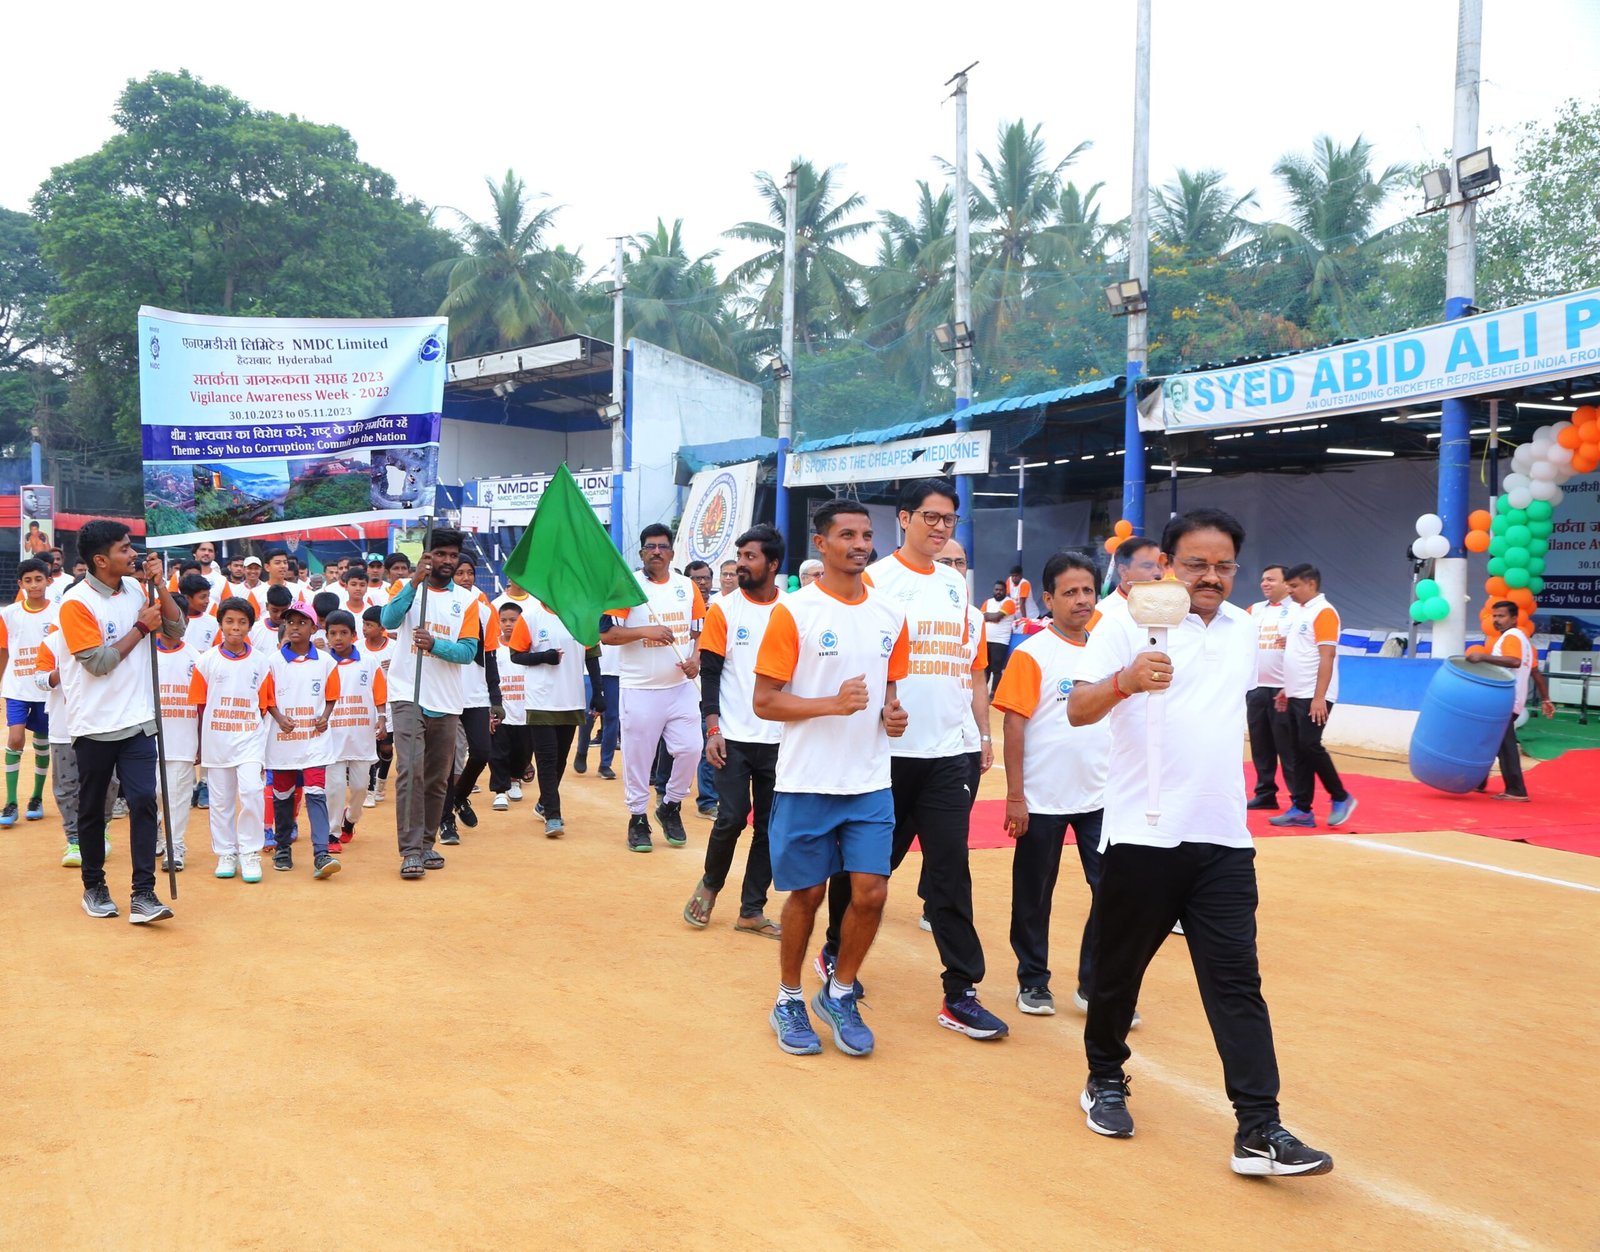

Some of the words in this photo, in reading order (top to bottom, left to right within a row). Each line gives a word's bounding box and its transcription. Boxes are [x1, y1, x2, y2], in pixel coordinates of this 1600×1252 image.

[182, 337, 237, 350] एनएमडीसी
[241, 337, 284, 351] लिमिटेड
[293, 339, 334, 350] NMDC
[338, 338, 388, 350] Limited
[237, 355, 271, 365] हैदराबाद
[278, 355, 332, 367] Hyderabad
[1194, 366, 1295, 413] SYED
[1310, 338, 1426, 398] ABID
[1444, 311, 1538, 374] ALI
[193, 371, 238, 386] सतर्कता
[243, 374, 309, 386] जागरूकता
[314, 373, 347, 386] सप्ताह
[352, 372, 384, 383] 2023
[1306, 400, 1318, 410] AN
[1320, 390, 1384, 408] OUTSTANDING
[1386, 377, 1444, 394] CRICKETER
[1447, 362, 1530, 386] REPRESENTED
[1533, 354, 1566, 370] INDIA
[1570, 348, 1600, 363] FRO
[190, 391, 243, 406] Vigilance
[246, 390, 312, 403] Awareness
[315, 389, 349, 401] Week
[360, 387, 390, 399] 2023
[229, 411, 283, 420] 30.10.2023
[286, 411, 295, 419] to
[298, 407, 352, 418] 05.11.2023
[235, 430, 250, 440] का
[253, 426, 282, 439] विरोध
[310, 426, 331, 438] राष्ट्र
[333, 424, 345, 435] के
[347, 422, 363, 434] प्रति
[365, 417, 393, 431] समर्पित
[396, 416, 408, 428] रहें
[172, 445, 200, 456] Theme
[207, 445, 224, 457] Say
[226, 444, 240, 454] No
[242, 445, 253, 453] to
[255, 441, 315, 454] Corruption;
[317, 438, 351, 449] Commit
[361, 434, 373, 443] the
[375, 432, 407, 442] Nation
[805, 457, 837, 473] SPORTS
[839, 456, 847, 471] IS
[849, 454, 866, 470] THE
[923, 441, 980, 462] MEDICINE
[497, 481, 538, 495] NMDC
[1548, 540, 1586, 551] ilance
[1549, 594, 1565, 604] Say
[1568, 594, 1579, 603] No
[1582, 595, 1592, 603] to
[663, 611, 684, 622] INDIA
[918, 621, 932, 635] FIT
[934, 621, 961, 637] INDIA
[160, 684, 171, 693] FIT
[221, 697, 231, 706] FIT
[296, 707, 314, 715] INDIA
